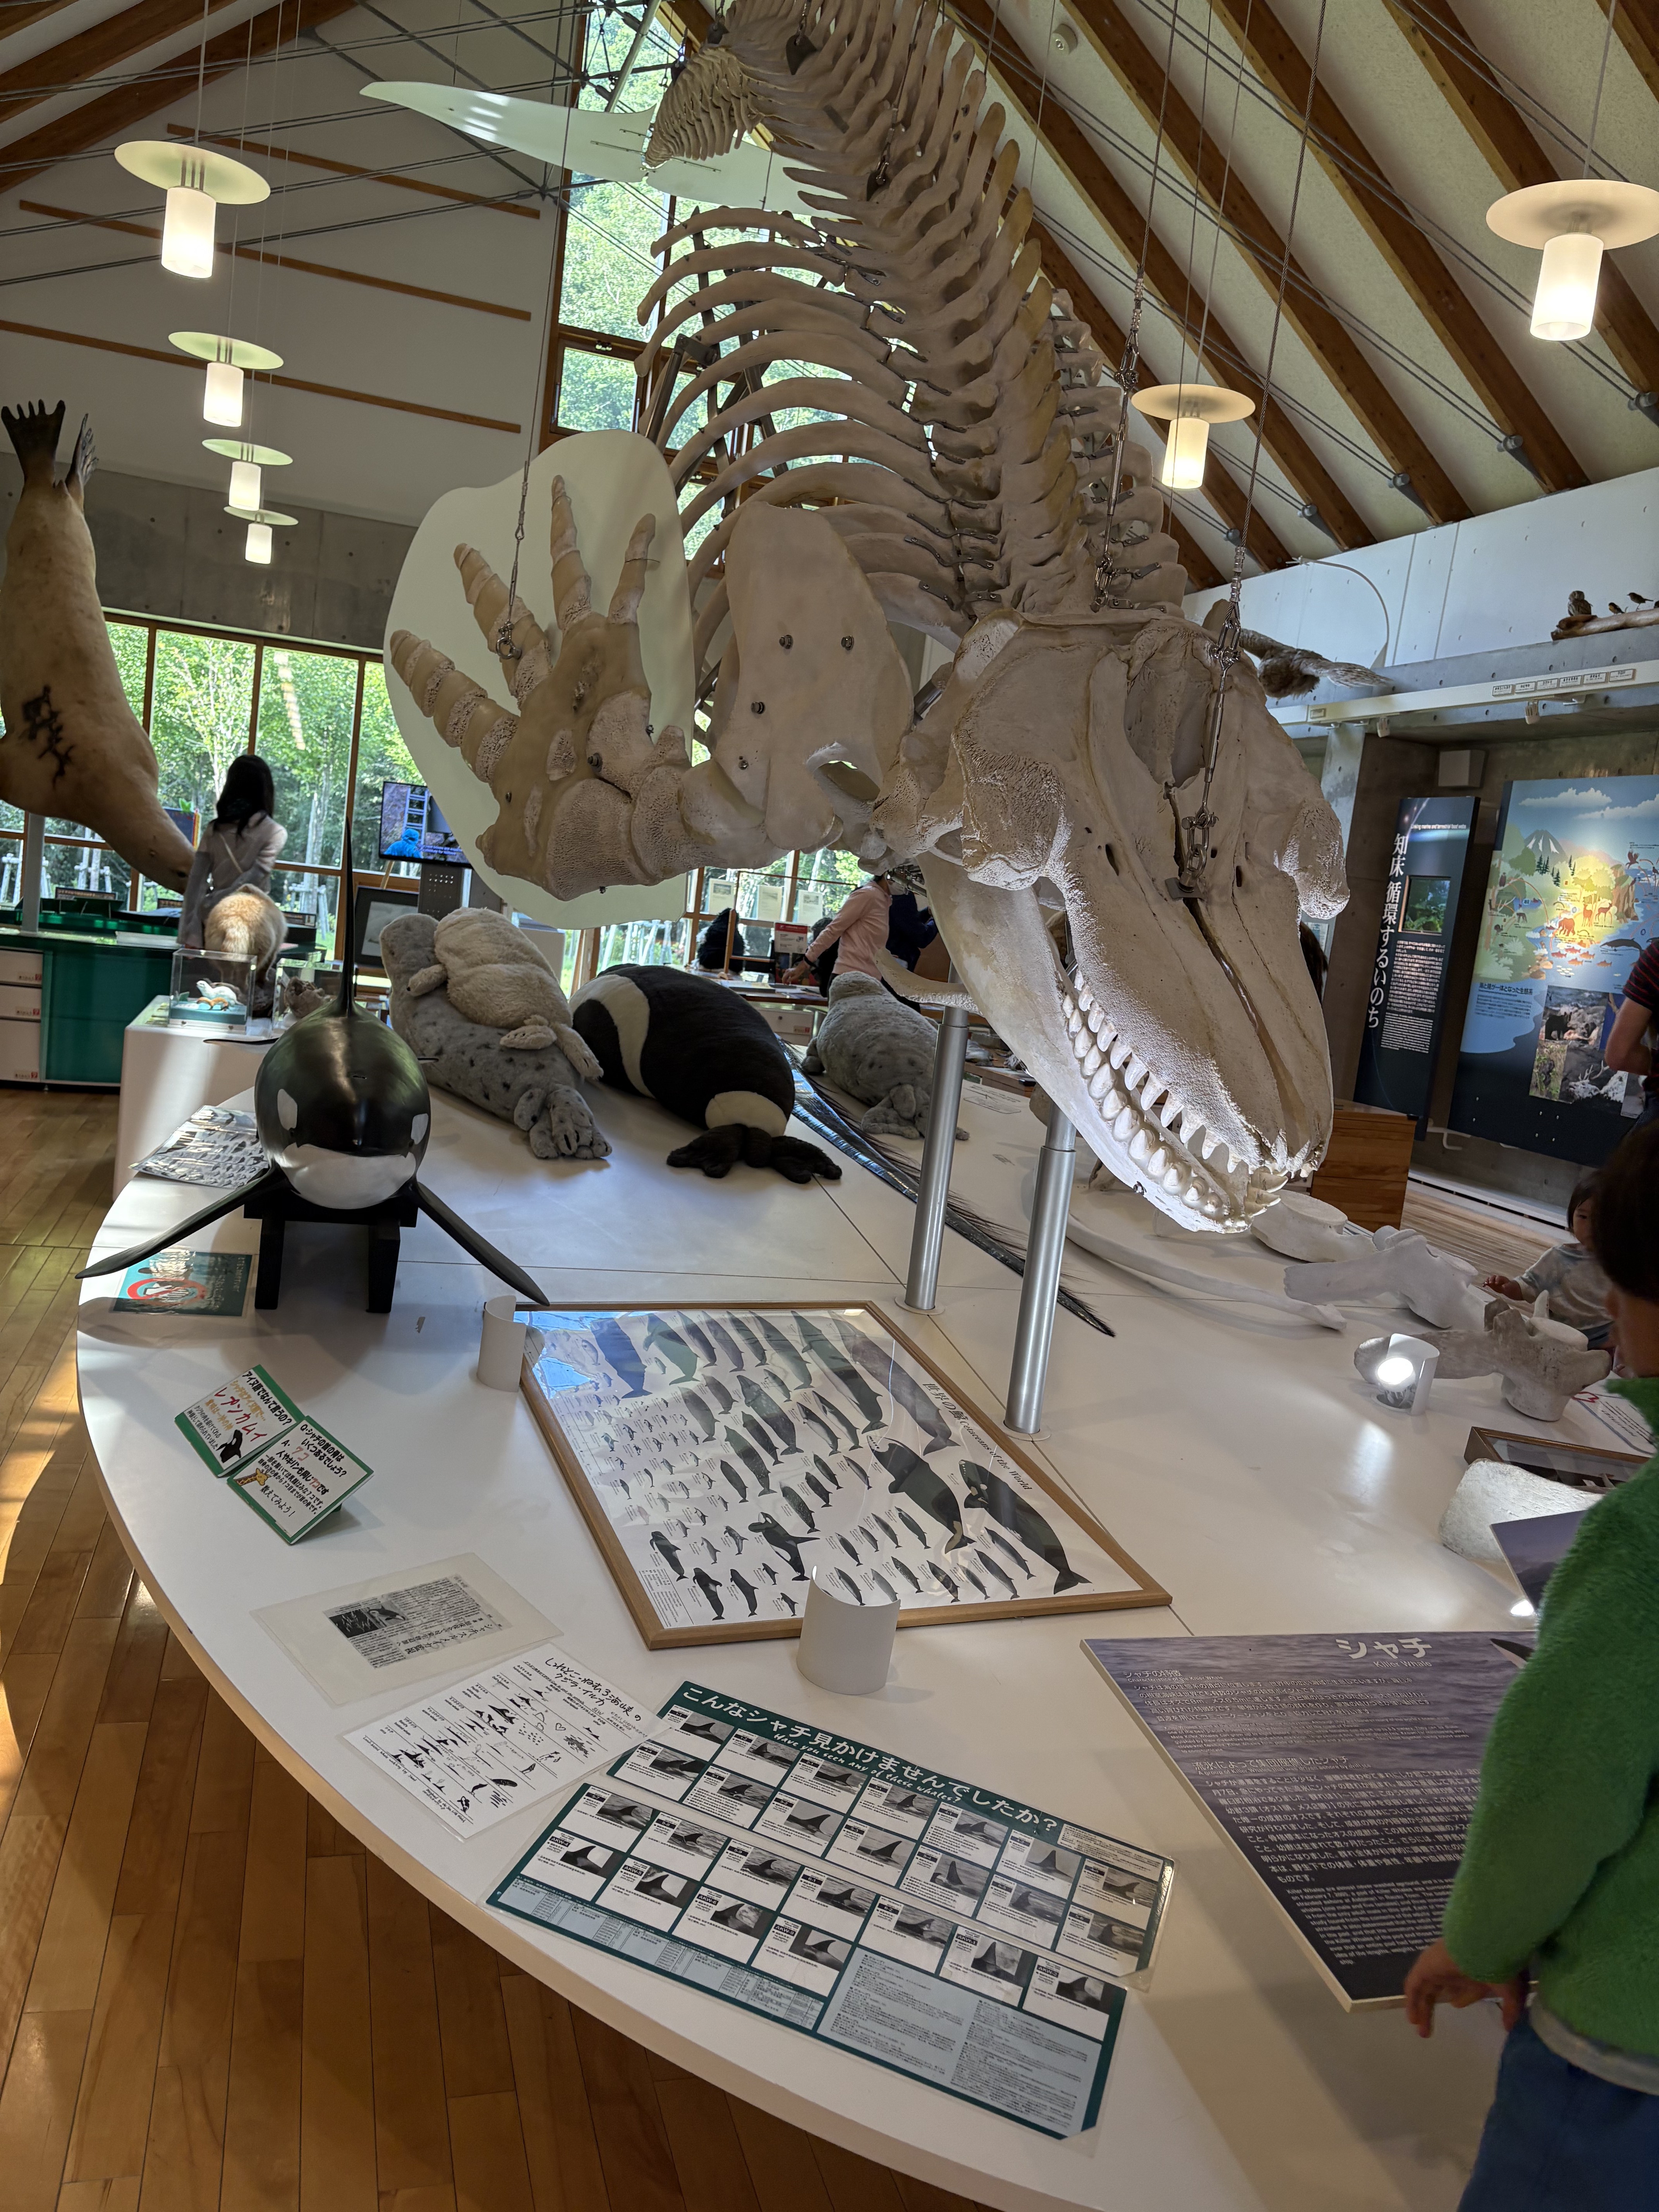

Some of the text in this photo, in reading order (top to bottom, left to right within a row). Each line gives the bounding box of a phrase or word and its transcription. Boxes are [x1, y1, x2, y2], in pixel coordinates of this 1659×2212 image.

[1368, 833, 1408, 1028] 知床 循環するいのち
[960, 1421, 991, 1451] Cetaceans
[989, 1451, 1001, 1460] of
[997, 1459, 1010, 1470] the
[1009, 1470, 1033, 1490] World
[1336, 1637, 1432, 1659] シャチ
[683, 1687, 1057, 1832] こんなシャチ見かけませんでしたか?
[773, 1733, 960, 1803] Have you seen any of these whales?
